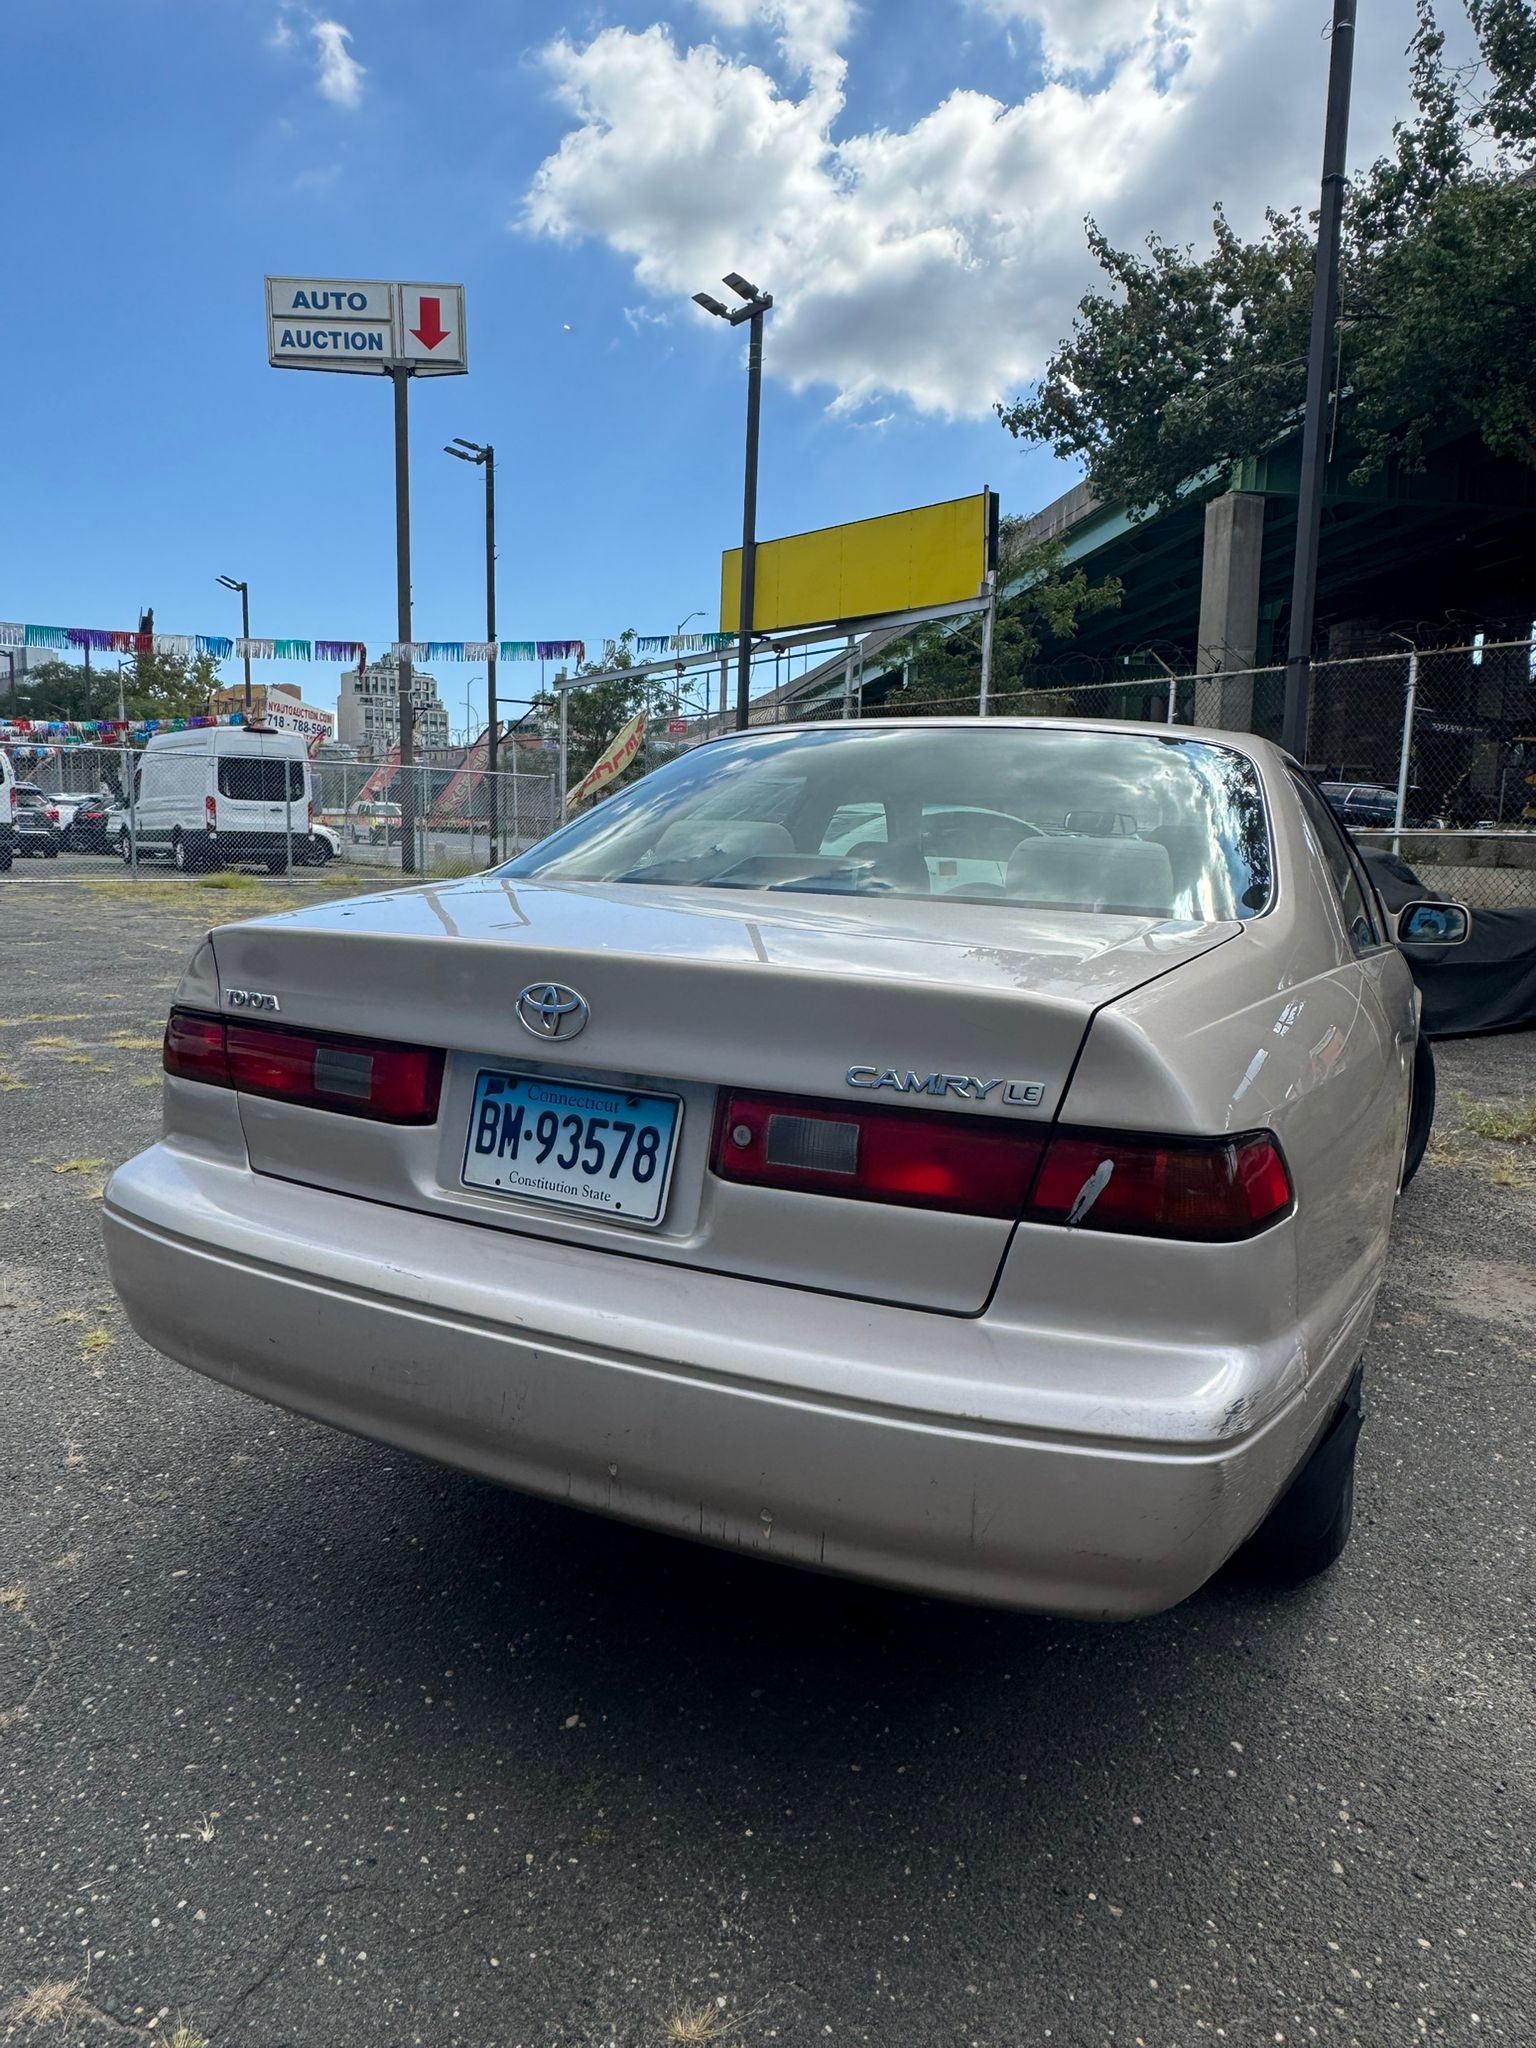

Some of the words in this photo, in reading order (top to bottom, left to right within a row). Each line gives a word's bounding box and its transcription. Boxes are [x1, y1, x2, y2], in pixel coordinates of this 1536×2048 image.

[291, 290, 368, 311] AUTO
[280, 329, 384, 351] AUCTION
[267, 713, 285, 728] 718
[268, 701, 332, 724] NYAUTOAUCTION.COM
[845, 1065, 1003, 1100] CAMRY
[1005, 1083, 1042, 1103] LE
[527, 1083, 620, 1114] Connecticut
[508, 1170, 578, 1196] Constitution
[581, 1184, 612, 1202] State
